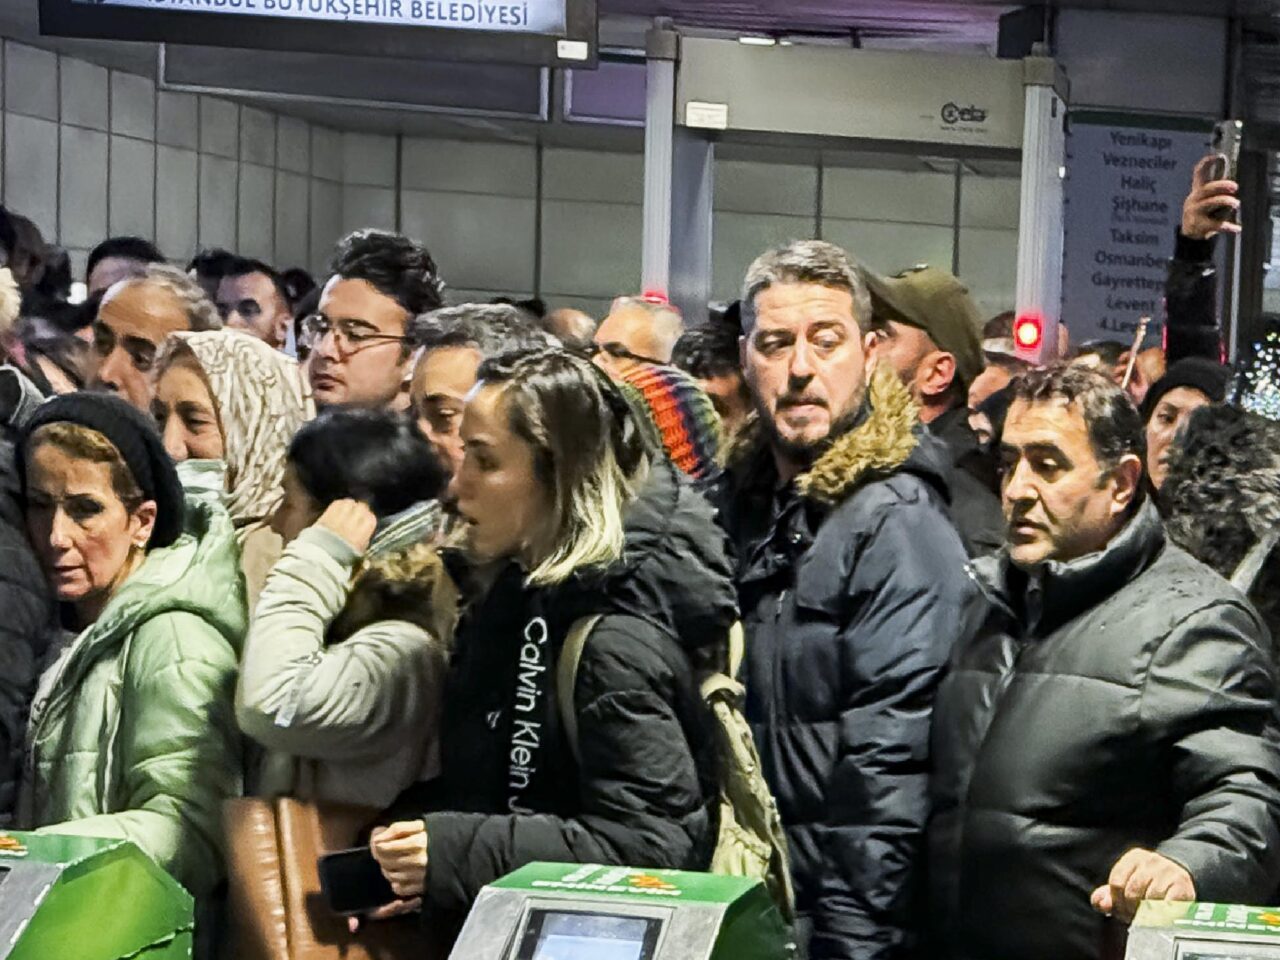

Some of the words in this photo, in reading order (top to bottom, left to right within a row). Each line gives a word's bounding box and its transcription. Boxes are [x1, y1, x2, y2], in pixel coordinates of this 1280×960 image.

[411, 1, 528, 26] BELEDİYESİ
[1102, 152, 1178, 170] Vezneciler
[1110, 228, 1159, 245] Taksim
[514, 616, 548, 712] Calvin
[508, 720, 542, 789] Klein
